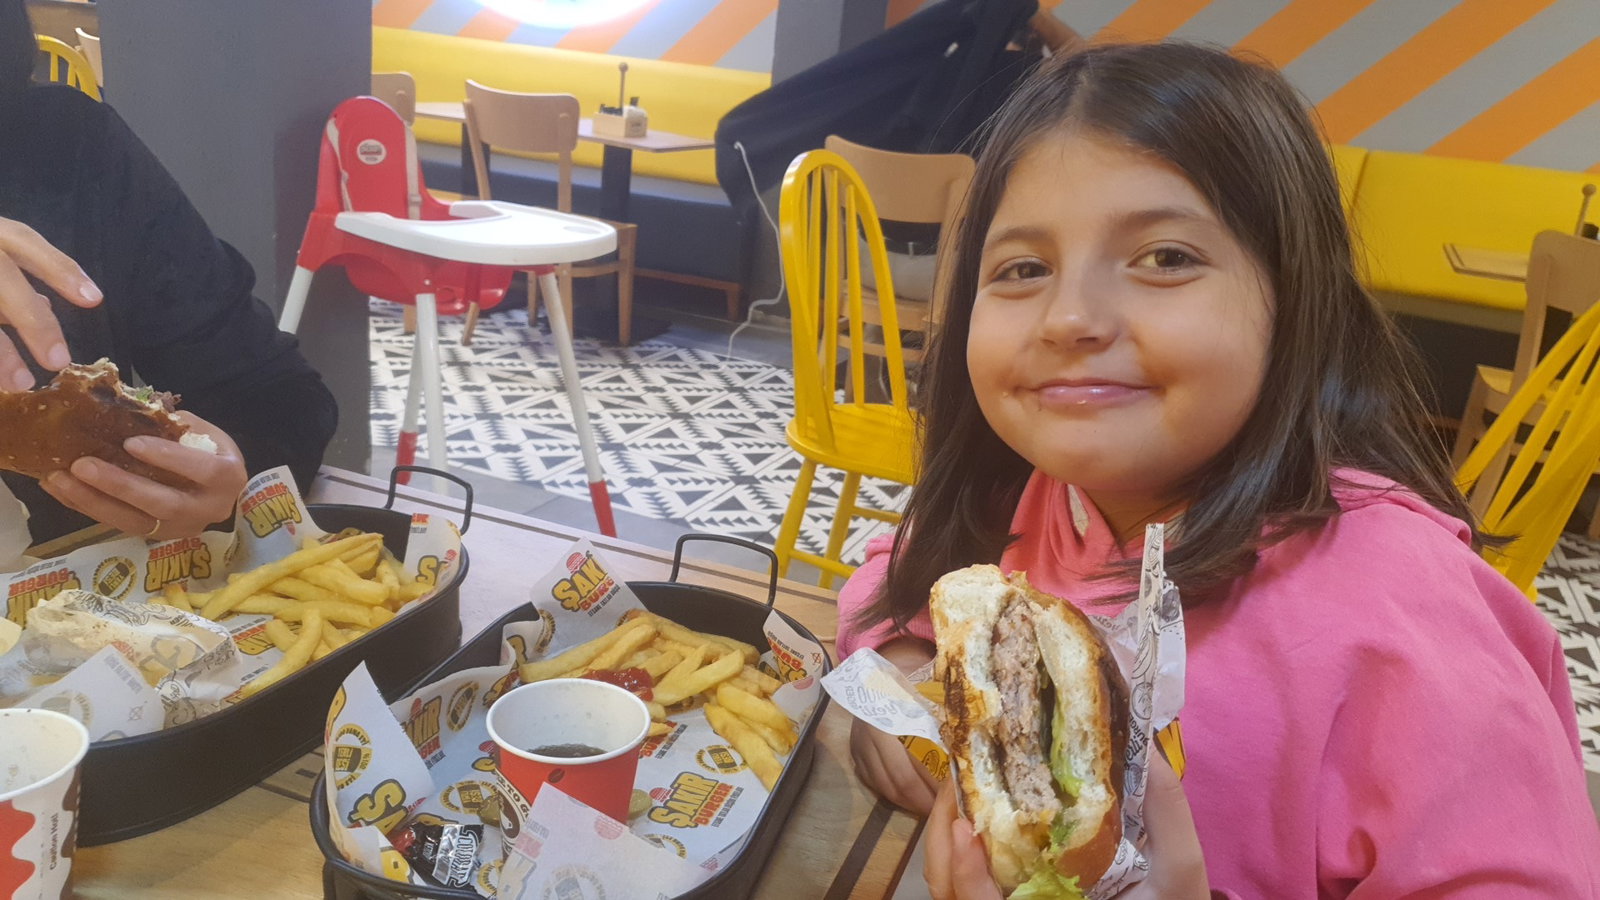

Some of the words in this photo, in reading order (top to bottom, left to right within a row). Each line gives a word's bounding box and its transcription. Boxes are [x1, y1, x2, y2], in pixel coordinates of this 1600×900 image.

[506, 784, 520, 802] TO
[693, 782, 734, 826] BURGER
[50, 834, 58, 870] Caution
